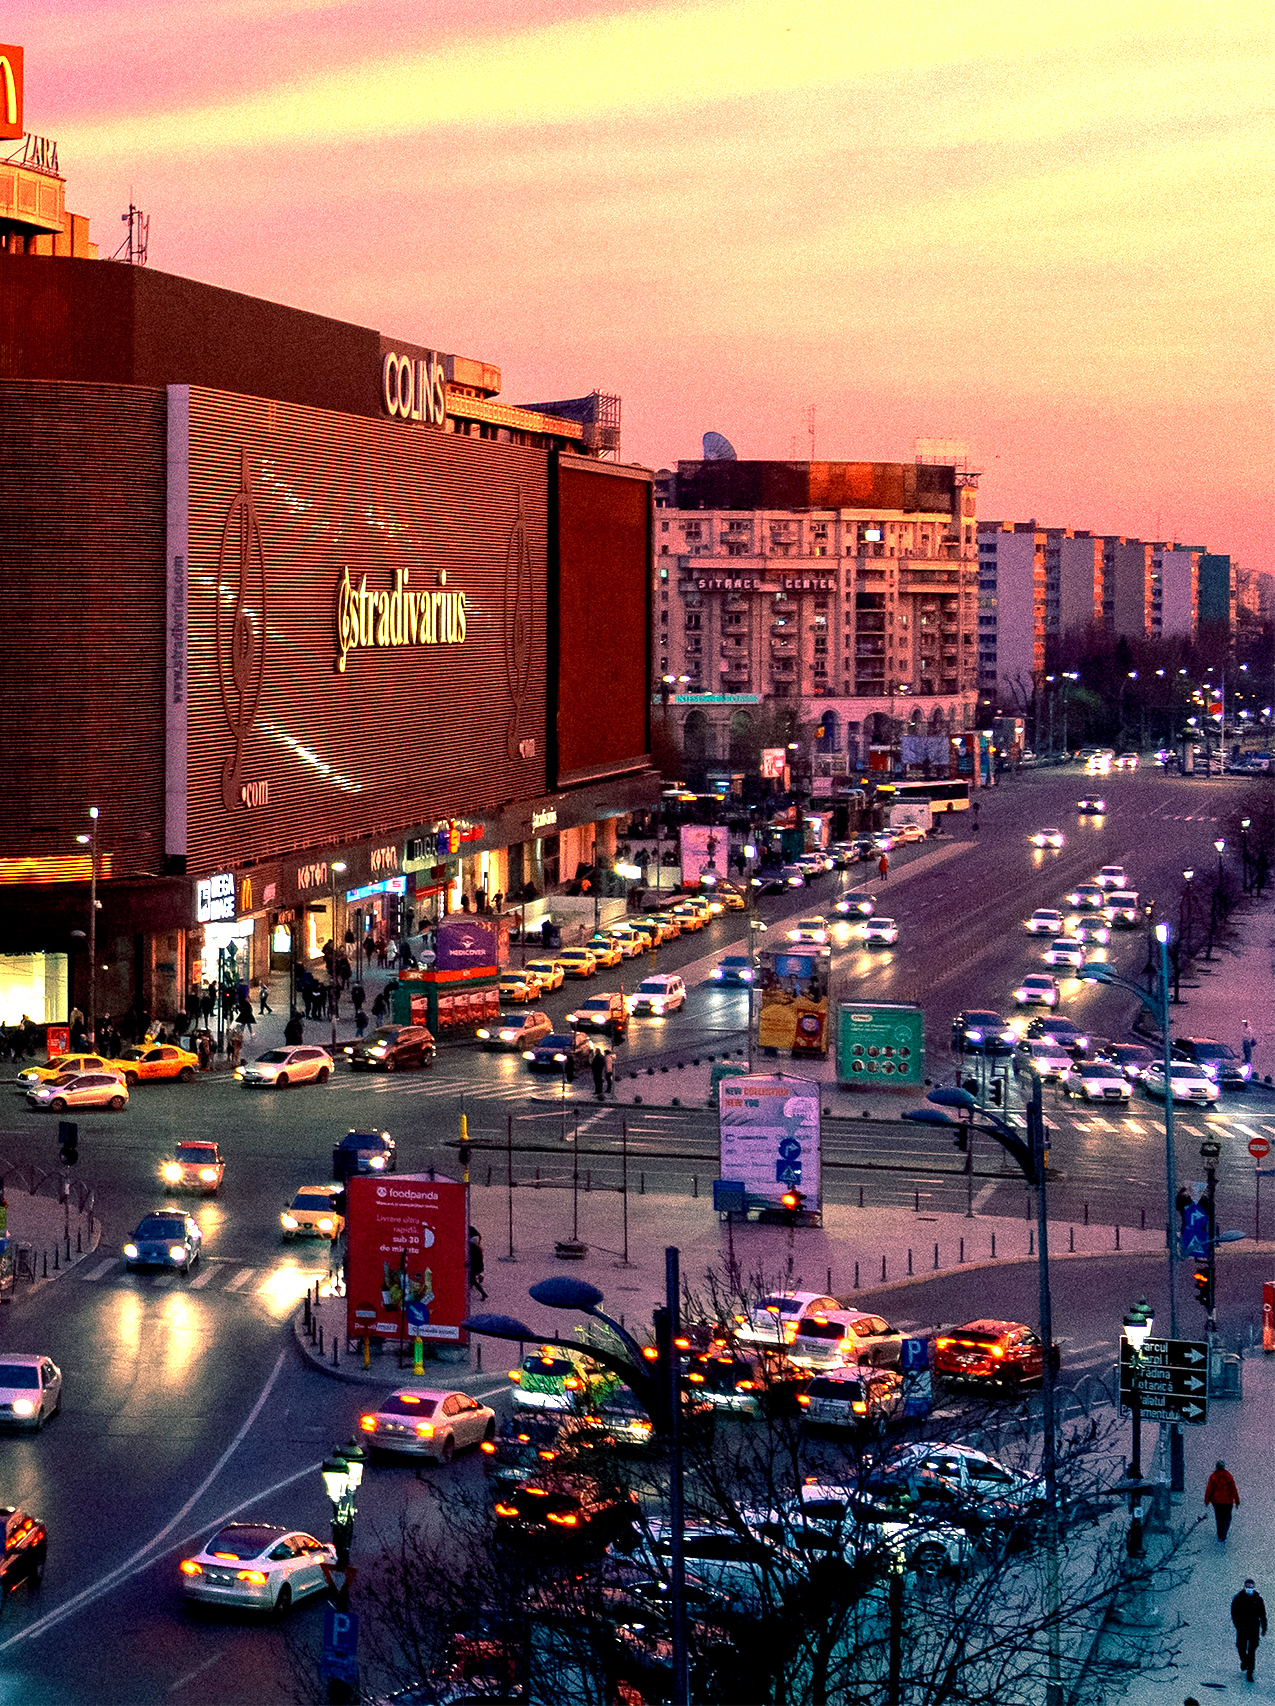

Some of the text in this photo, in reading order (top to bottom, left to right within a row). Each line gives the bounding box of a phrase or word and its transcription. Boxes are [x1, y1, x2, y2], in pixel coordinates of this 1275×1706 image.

[23, 132, 59, 171] ZARA
[384, 351, 445, 425] COLIN'S
[785, 579, 835, 589] CENTER
[338, 565, 466, 673] stradivarius
[371, 845, 398, 871] KOTON
[298, 862, 328, 889] KOTON
[389, 1188, 439, 1200] foodpanda
[376, 1214, 402, 1224] Livrare
[393, 1236, 408, 1244] sub
[379, 1244, 391, 1252] de
[908, 1340, 922, 1365] P
[1137, 1341, 1168, 1352] arcul
[1137, 1353, 1163, 1364] arol
[1135, 1366, 1171, 1379] rădina
[1137, 1395, 1166, 1407] alatul
[1121, 1404, 1181, 1420] Paamentului
[332, 1613, 351, 1646] P
